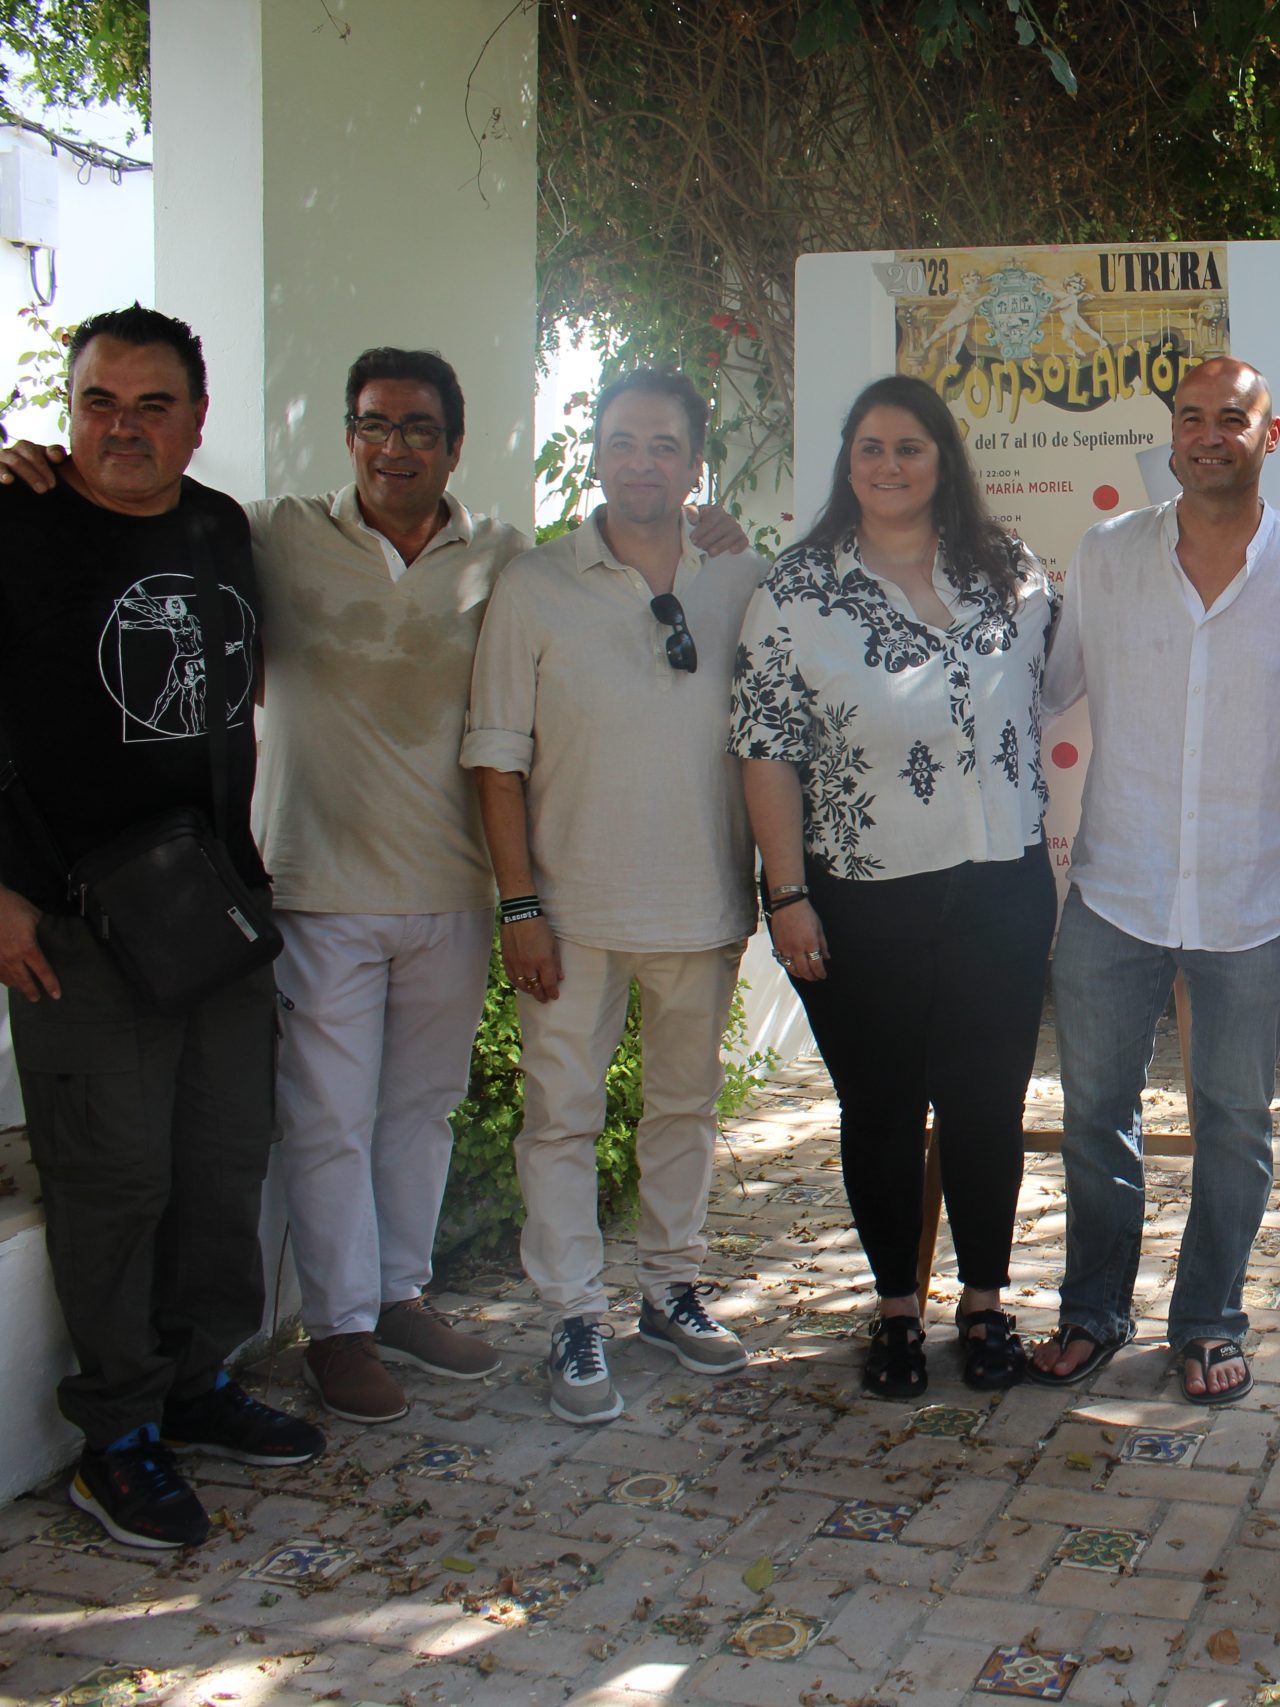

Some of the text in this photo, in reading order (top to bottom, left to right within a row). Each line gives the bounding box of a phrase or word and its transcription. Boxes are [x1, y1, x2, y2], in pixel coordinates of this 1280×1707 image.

[1097, 250, 1223, 294] UTRERA
[974, 429, 1154, 450] del 7 al 10 de Septiembre
[986, 469, 1020, 478] 22:00 H
[986, 479, 1074, 494] MARÍA MORIEL
[1015, 514, 1022, 522] H
